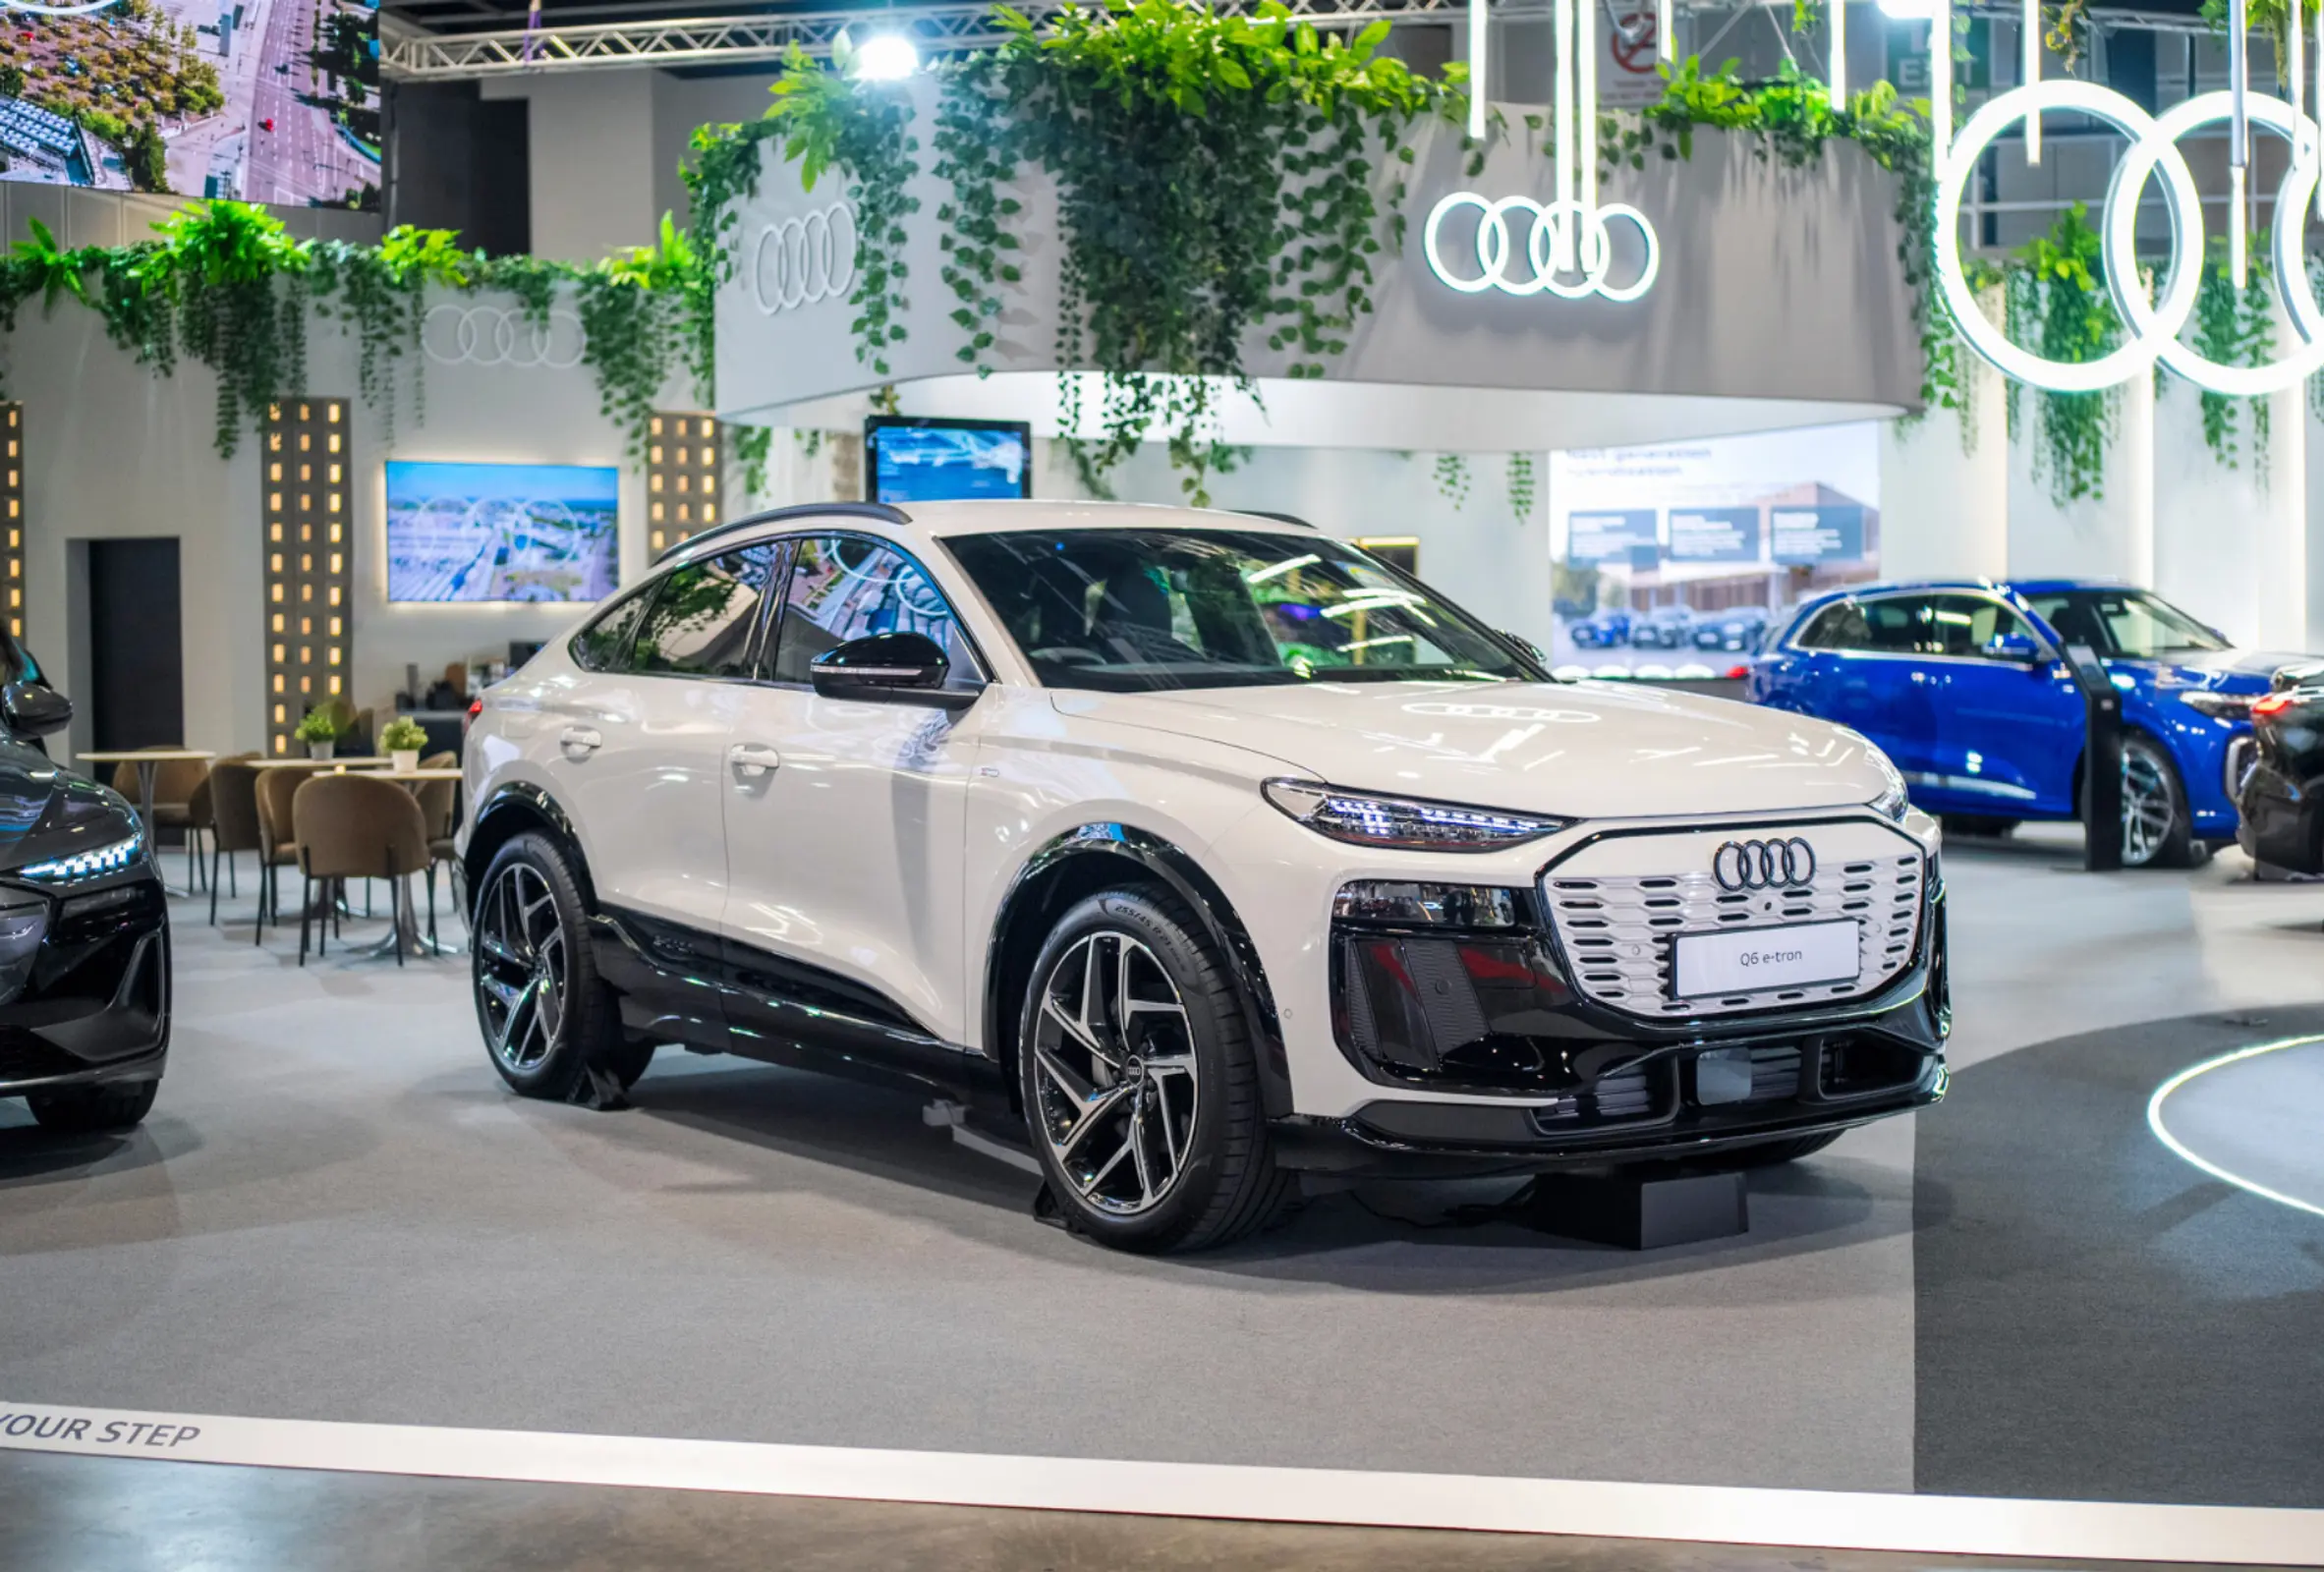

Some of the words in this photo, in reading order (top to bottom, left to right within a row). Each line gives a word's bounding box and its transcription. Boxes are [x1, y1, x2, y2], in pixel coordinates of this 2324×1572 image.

[1899, 57, 1980, 86] ET
[1740, 952, 1759, 967] Q6
[1763, 951, 1802, 964] e-tron
[95, 1421, 201, 1448] STEP
